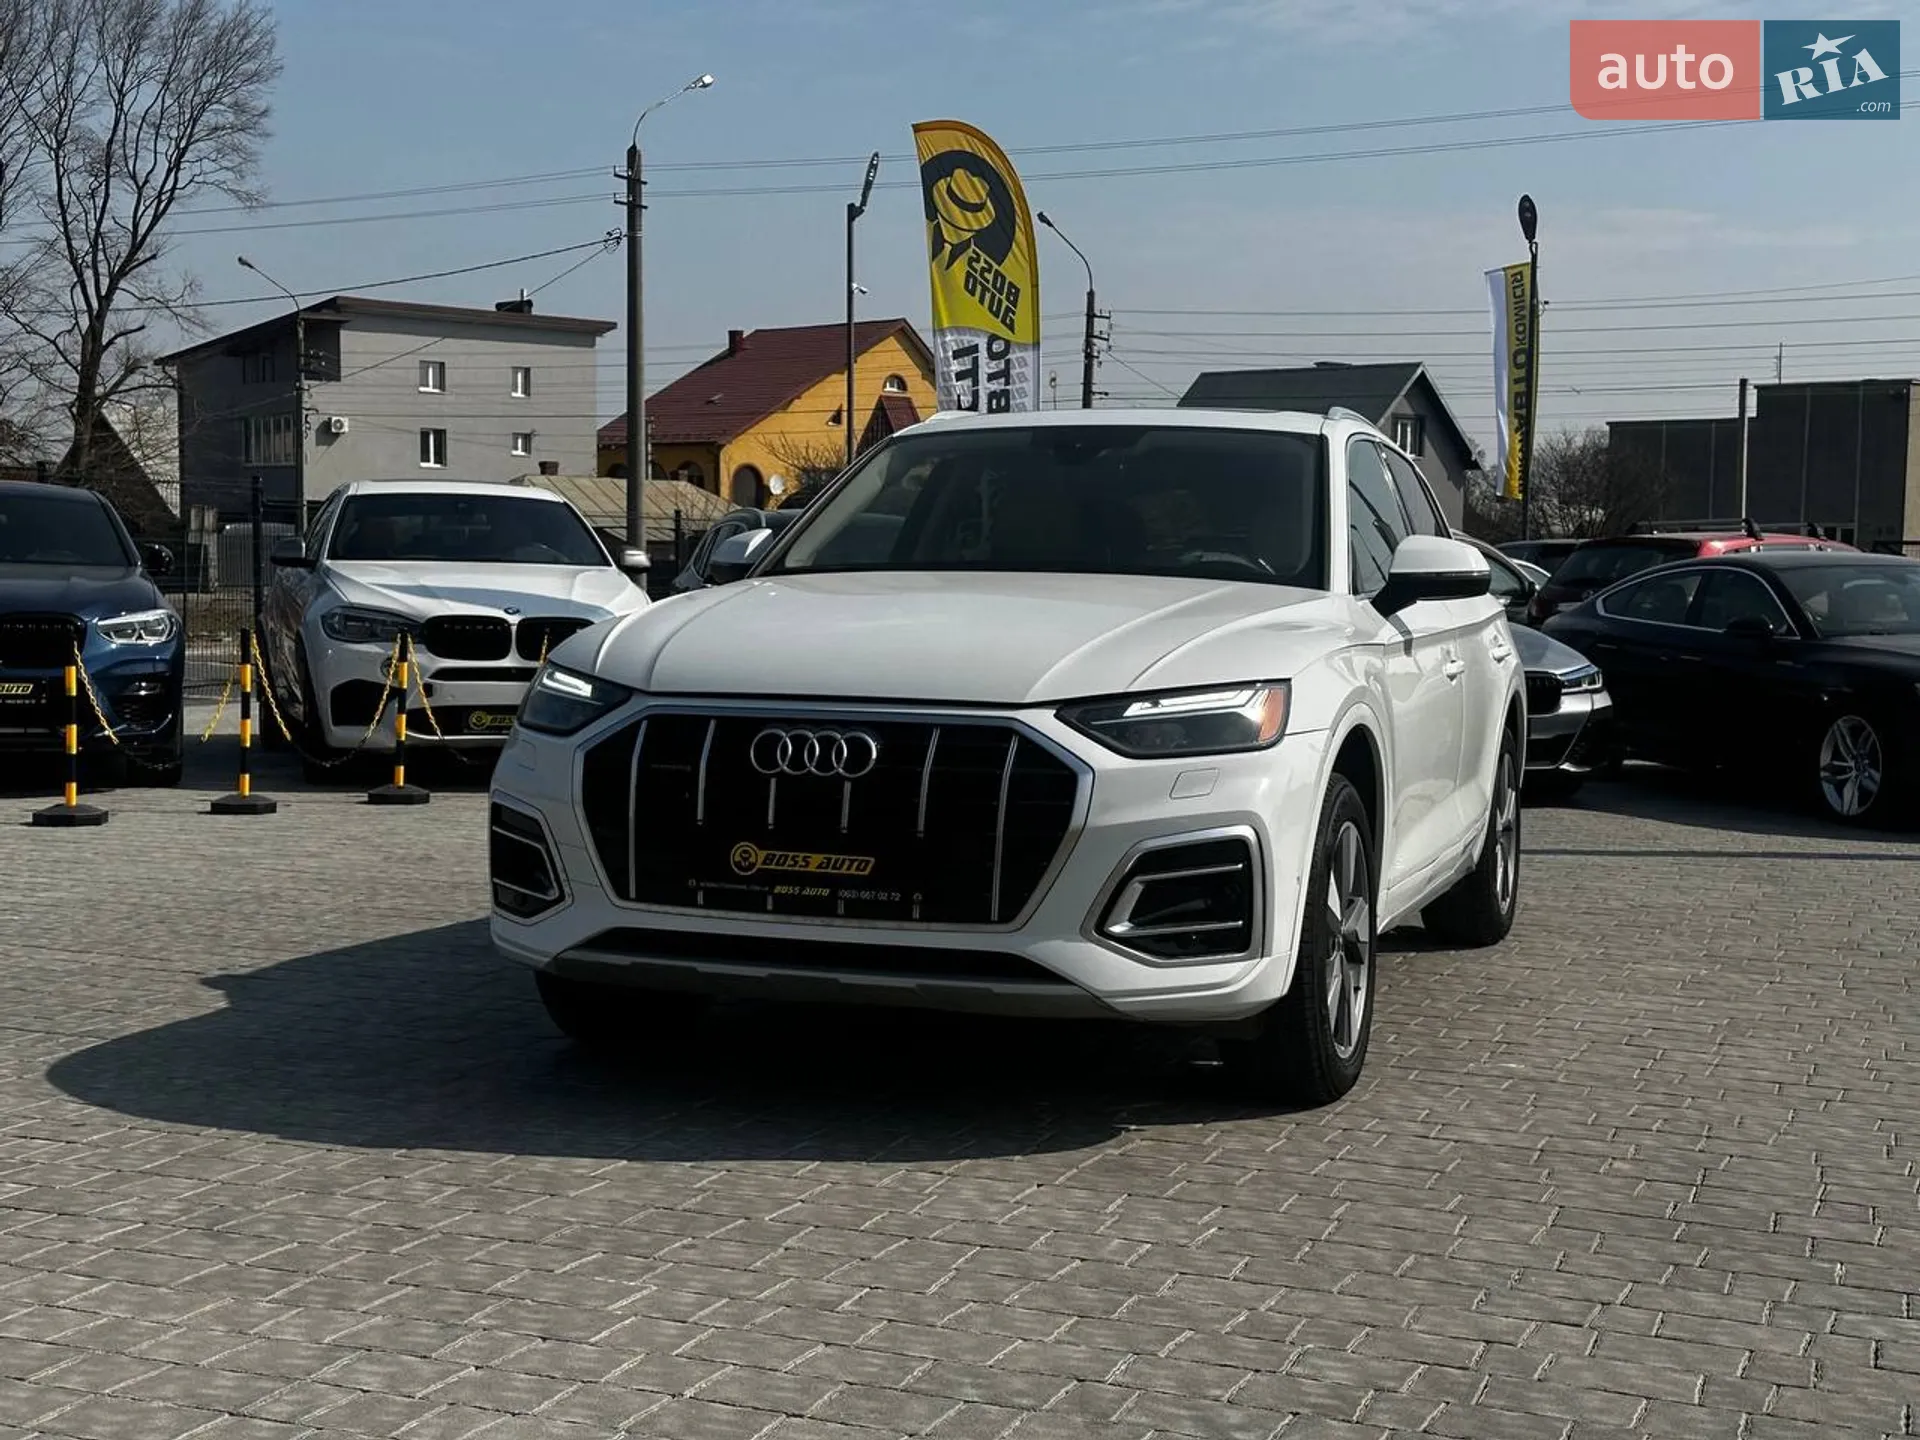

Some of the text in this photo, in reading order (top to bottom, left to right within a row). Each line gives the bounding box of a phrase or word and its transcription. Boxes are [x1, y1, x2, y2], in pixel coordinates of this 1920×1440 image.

[761, 851, 873, 873] BOSS AUTO
[773, 884, 801, 895] BOSS
[801, 886, 831, 897] AUTO
